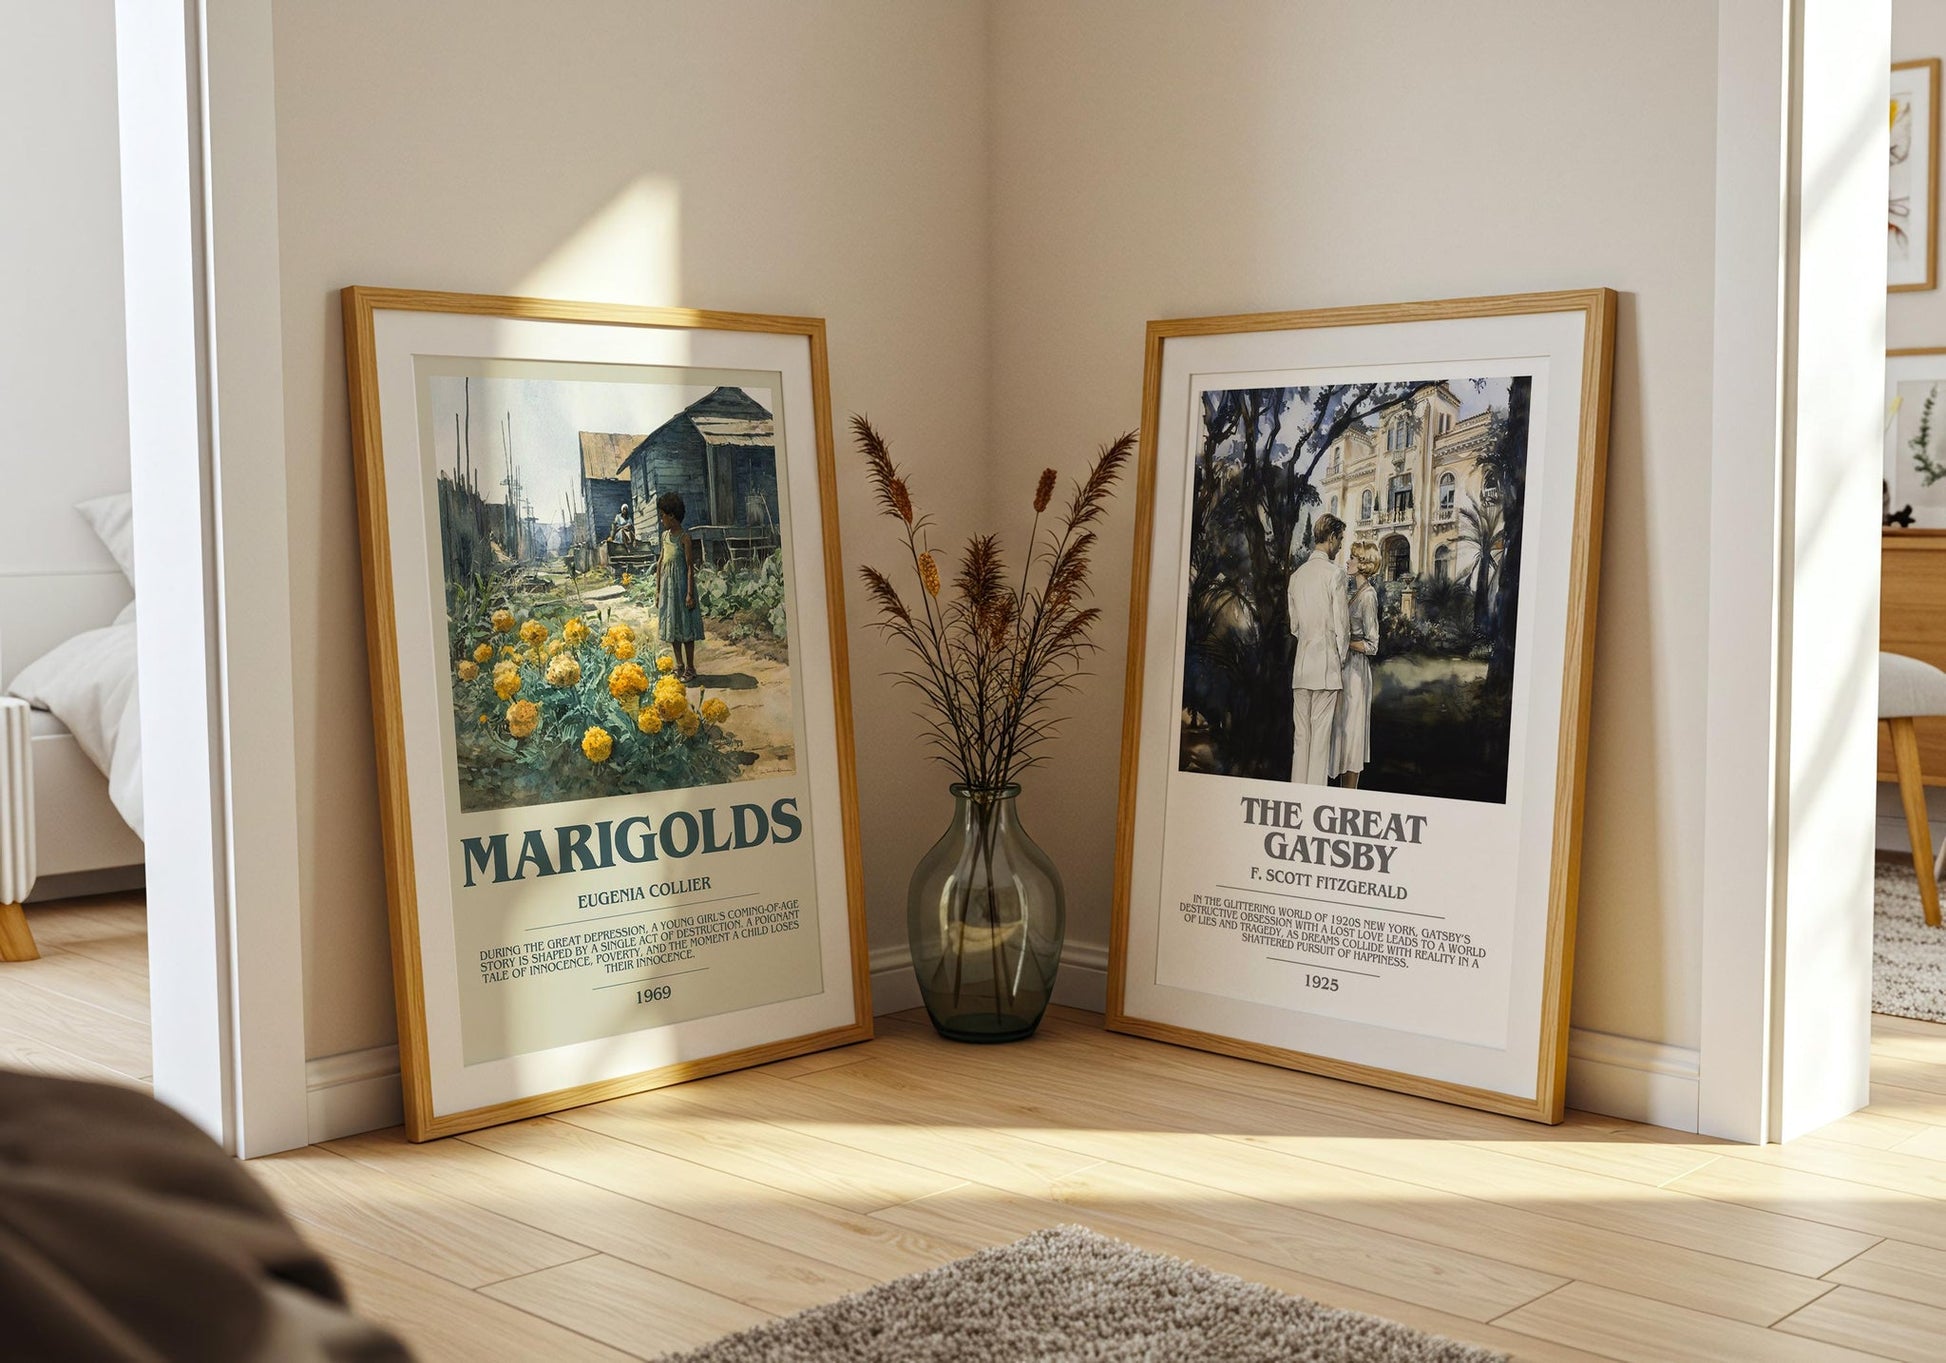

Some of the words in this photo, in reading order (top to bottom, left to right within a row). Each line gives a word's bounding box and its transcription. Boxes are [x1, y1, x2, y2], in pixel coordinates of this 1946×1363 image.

[1241, 796, 1302, 829] THE
[1313, 804, 1427, 844] GREAT
[461, 798, 802, 888] MARIGOLDS
[1264, 832, 1398, 873] GATSBY
[578, 887, 645, 909] EUGENIA
[649, 876, 711, 899] COLLIER
[1251, 867, 1262, 880] F.
[1266, 870, 1312, 887] SCOTT
[1316, 876, 1408, 900] FITZGERALD
[480, 945, 520, 960] DURING
[523, 942, 544, 952] THE
[547, 935, 581, 949] GREAT
[652, 923, 658, 932] A
[661, 917, 694, 931] YOUNG
[728, 900, 798, 919] COMING-OF-AGE
[1180, 903, 1238, 919] DESTRUCTIVE
[1240, 912, 1292, 927] OBSESSION
[1295, 921, 1318, 932] WITH
[1321, 925, 1327, 933] A
[1331, 926, 1355, 937] LOST
[1358, 930, 1383, 941] LOVE
[1386, 934, 1418, 947] LEADS
[1421, 939, 1435, 950] TO
[1438, 943, 1445, 952] A
[1449, 944, 1486, 958] WORLD
[1193, 894, 1202, 903] IN
[1204, 896, 1221, 907] THE
[1224, 899, 1276, 914] GLITTERING
[1279, 907, 1312, 920] WORLD
[1315, 913, 1327, 922] OF
[1331, 915, 1361, 927] 1920S
[1364, 920, 1385, 931] NEW
[481, 958, 516, 972] STORY
[519, 956, 528, 966] IS
[532, 950, 572, 963] SHAPED
[576, 944, 588, 956] BY
[592, 944, 598, 953] A
[601, 937, 636, 951] SINGLE
[639, 934, 657, 946] ACT
[661, 931, 674, 941] OF
[747, 917, 753, 927] A
[755, 910, 799, 925] POIGNANT
[482, 970, 509, 983] TALE
[512, 967, 526, 978] OF
[646, 943, 666, 955] AND
[669, 940, 687, 950] THE
[690, 934, 730, 947] MOMENT
[733, 931, 739, 939] A
[742, 927, 768, 938] CHILD
[771, 920, 799, 933] LOSES
[1184, 914, 1196, 922] OF
[1199, 916, 1216, 926] LIES
[1219, 920, 1237, 930] AND
[1287, 930, 1299, 939] AS
[1301, 931, 1339, 946] DREAMS
[1343, 938, 1384, 952] COLLIDE
[1387, 945, 1412, 957] WITH
[1415, 950, 1455, 964] REALITY
[1458, 956, 1469, 966] IN
[1472, 959, 1479, 968] A
[1242, 933, 1294, 949] SHATTERED
[1297, 941, 1335, 956] PURSUIT
[1338, 948, 1351, 958] OF
[605, 959, 634, 973] THEIR
[1305, 975, 1339, 992] 1925
[636, 986, 671, 1004] 1969
